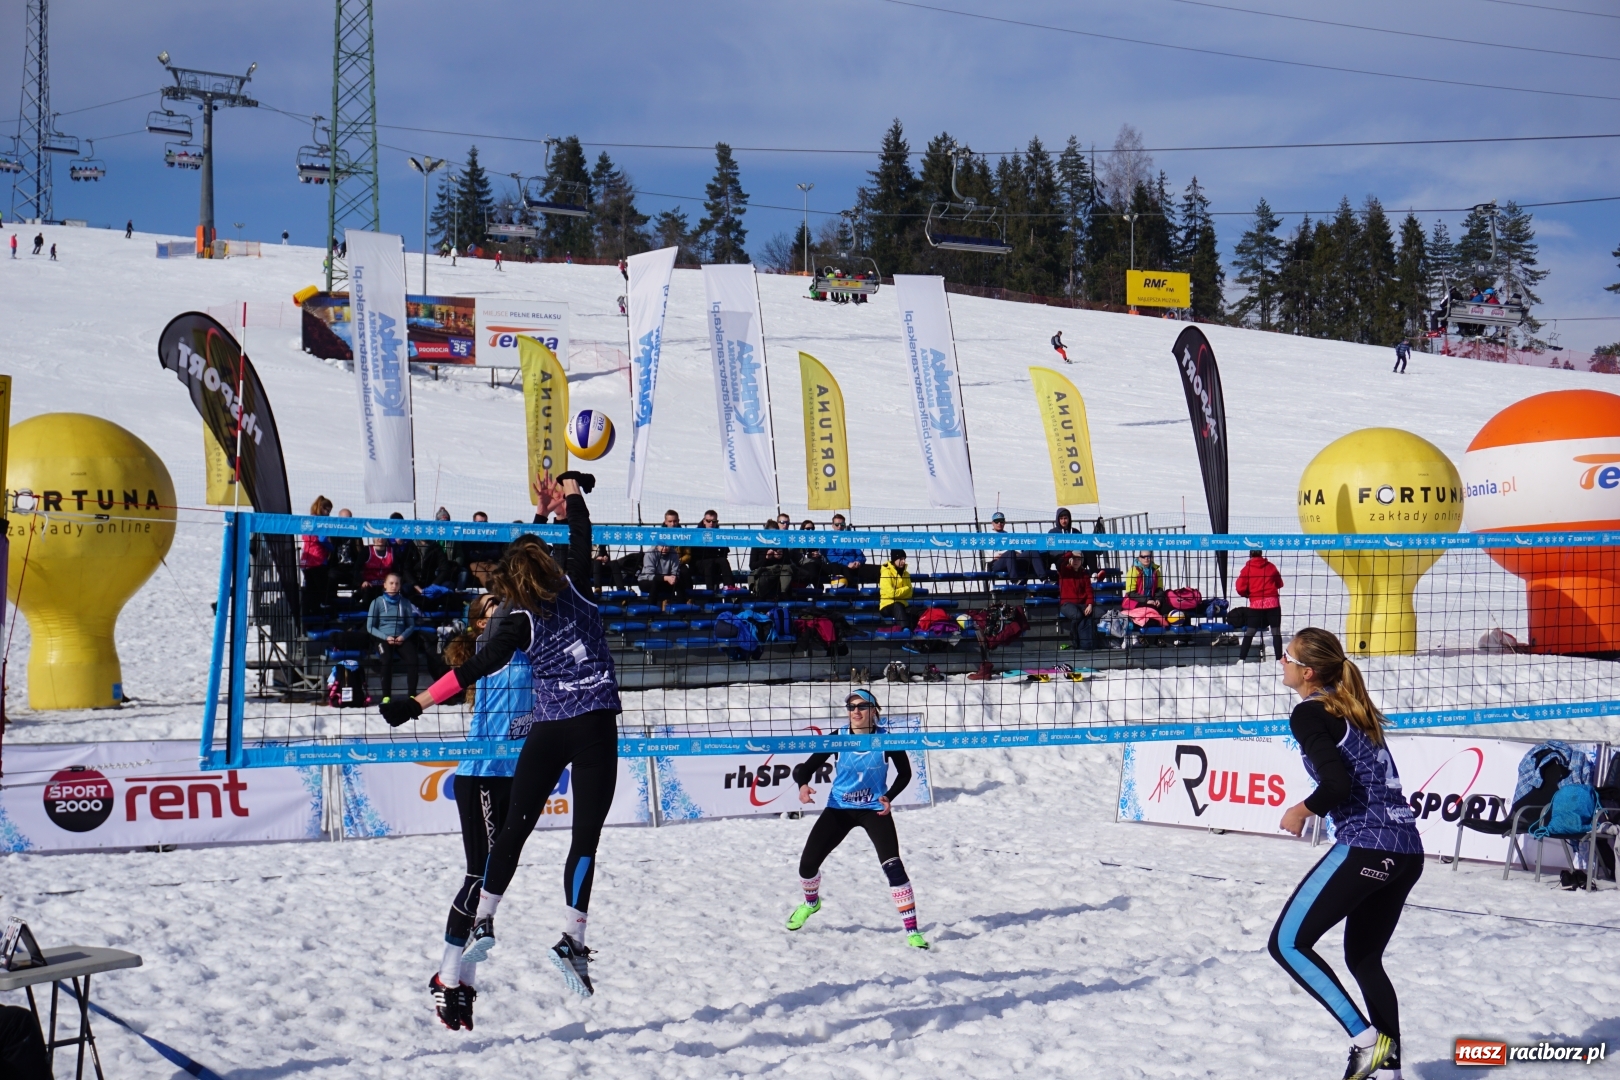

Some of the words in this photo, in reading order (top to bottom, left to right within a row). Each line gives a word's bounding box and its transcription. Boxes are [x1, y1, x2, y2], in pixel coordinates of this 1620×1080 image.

[1143, 278, 1168, 288] RMF
[531, 312, 562, 320] RELAKSU
[452, 342, 467, 353] 35
[13, 488, 160, 515] ORTUNA
[1358, 484, 1464, 506] FORTUNA
[1369, 510, 1428, 524] zakłady
[1434, 510, 1461, 522] online
[96, 522, 151, 534] online
[672, 533, 692, 541] EVENT
[462, 747, 484, 755] EVENT
[1175, 744, 1287, 817] RULES
[49, 784, 108, 799] SPORT
[124, 770, 249, 822] rent
[55, 799, 103, 813] 2000
[1409, 790, 1507, 822] SPORT
[1362, 869, 1388, 881] ORLEN
